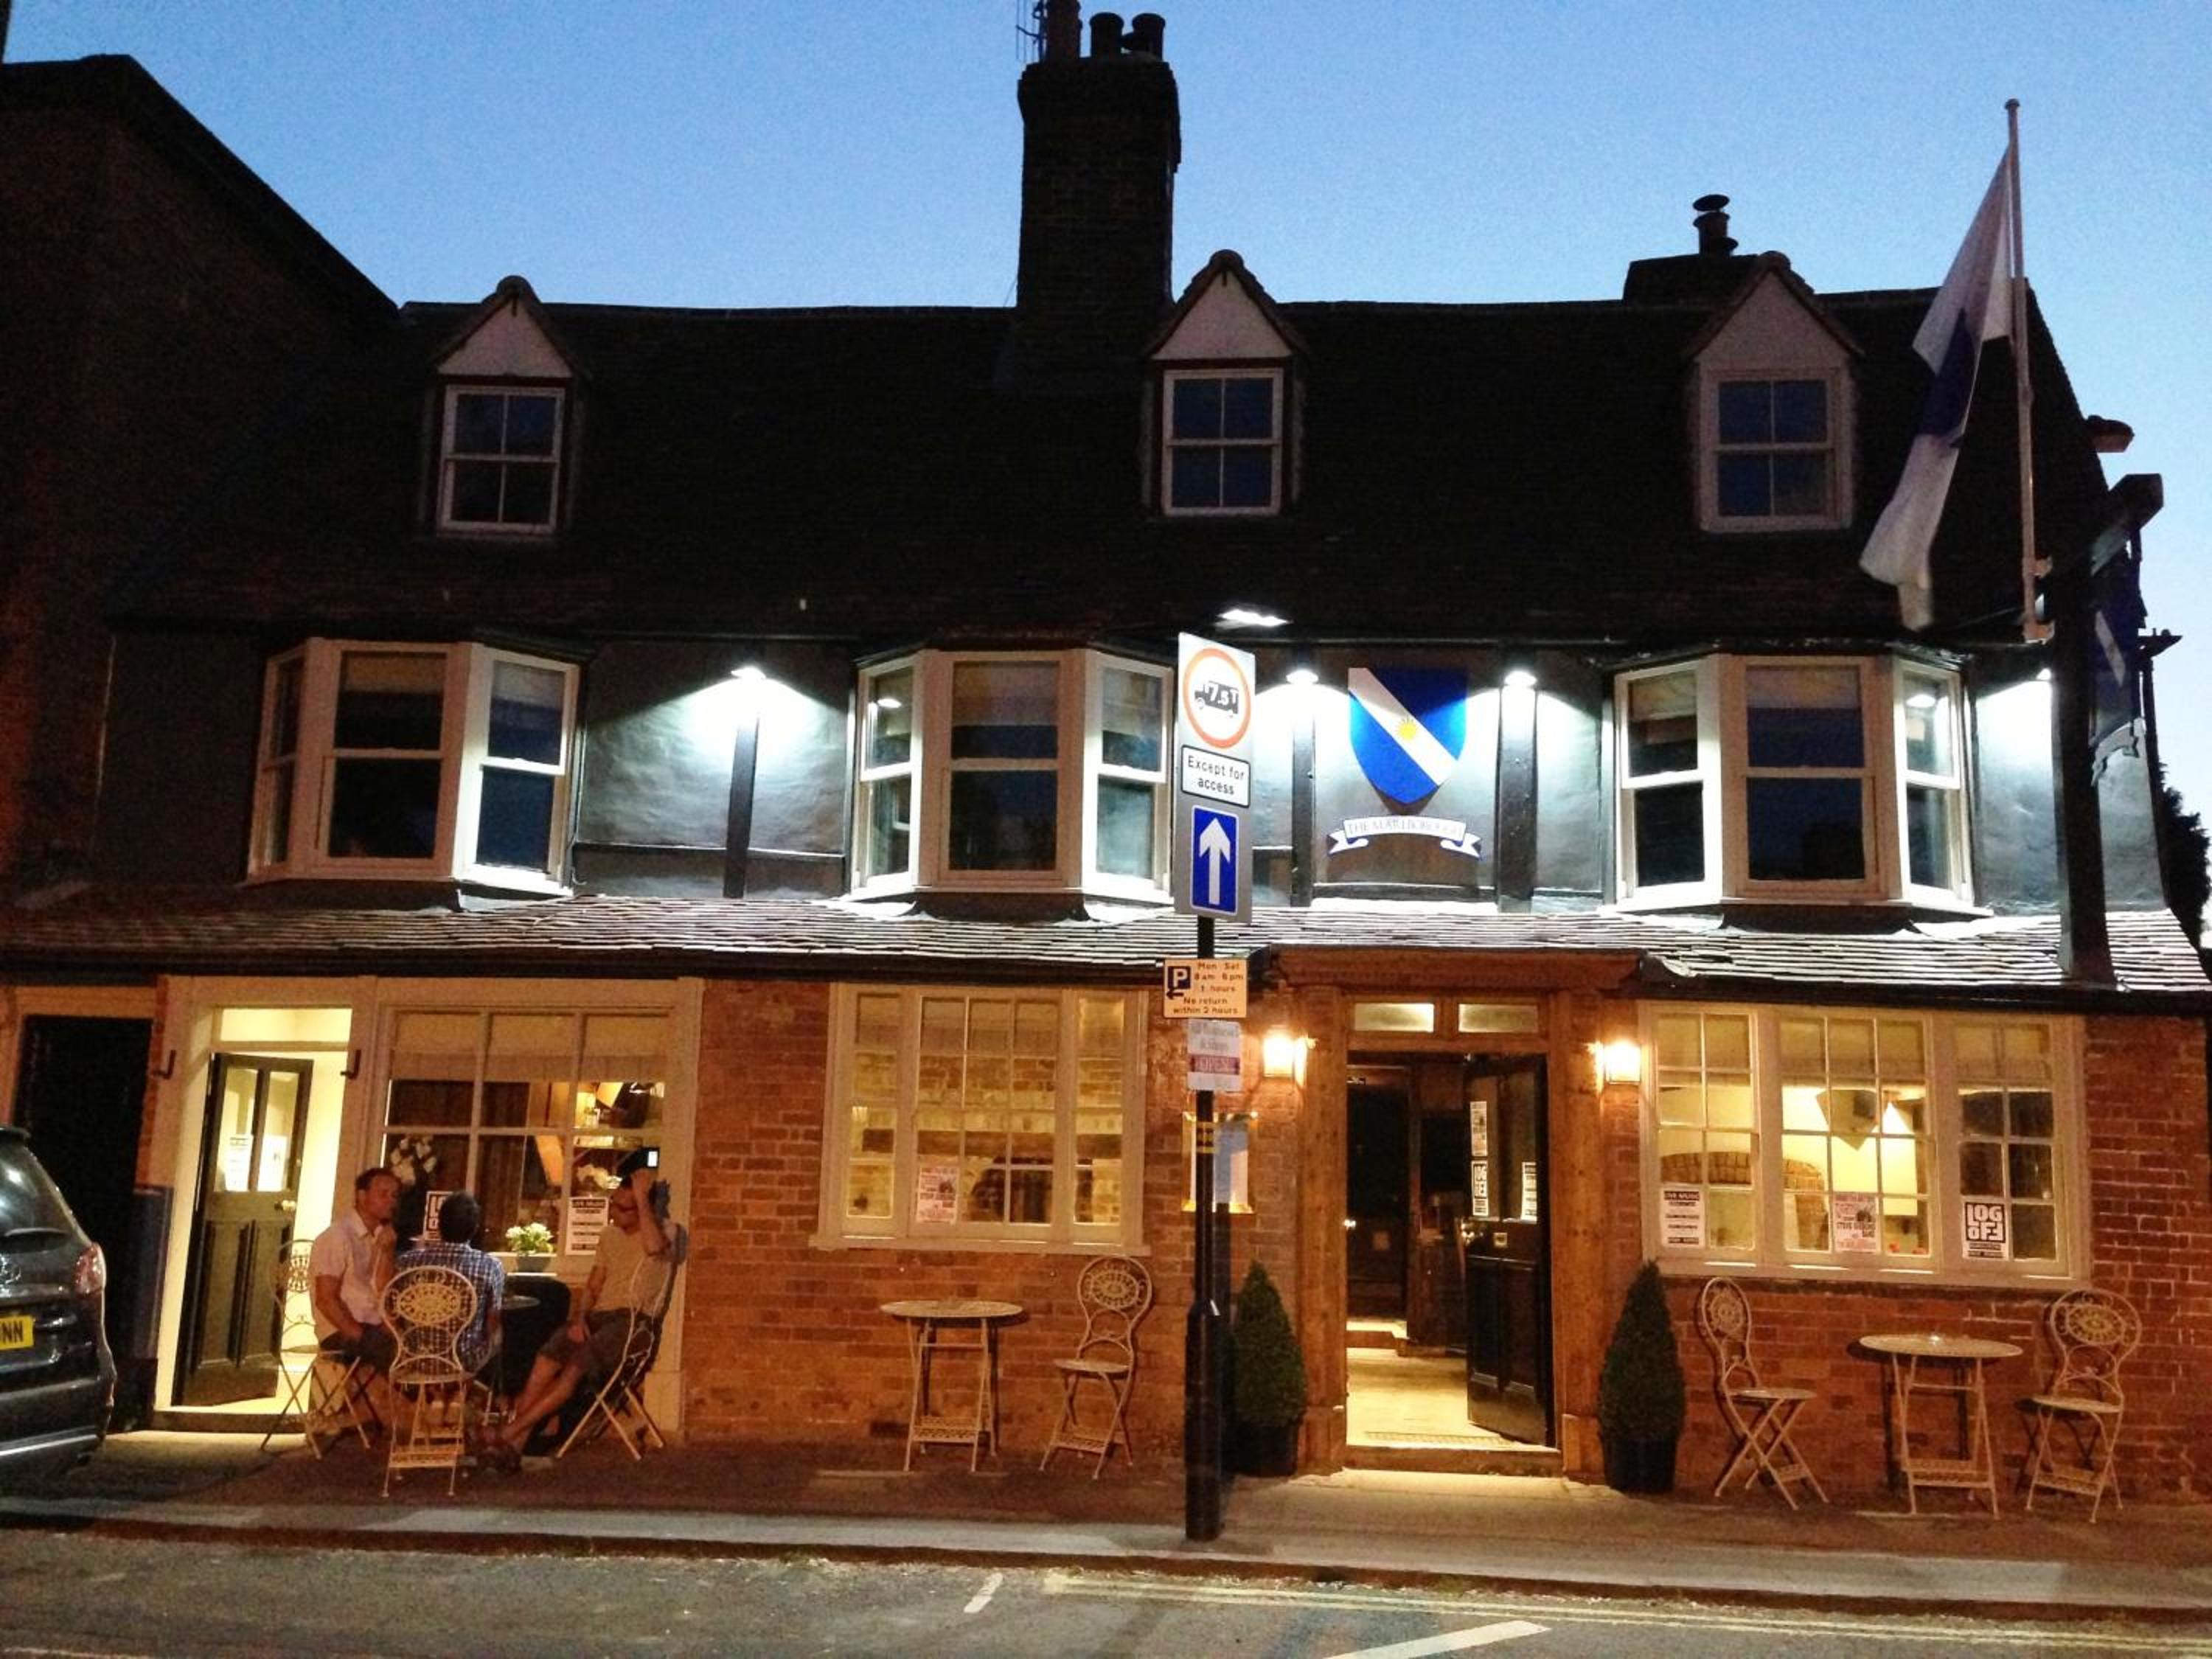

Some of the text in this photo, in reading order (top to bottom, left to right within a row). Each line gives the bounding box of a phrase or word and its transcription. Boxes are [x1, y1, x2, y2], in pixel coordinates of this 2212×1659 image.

[1188, 755, 1244, 780] Except for
[1198, 778, 1234, 795] access
[1966, 1203, 2003, 1226] LOG
